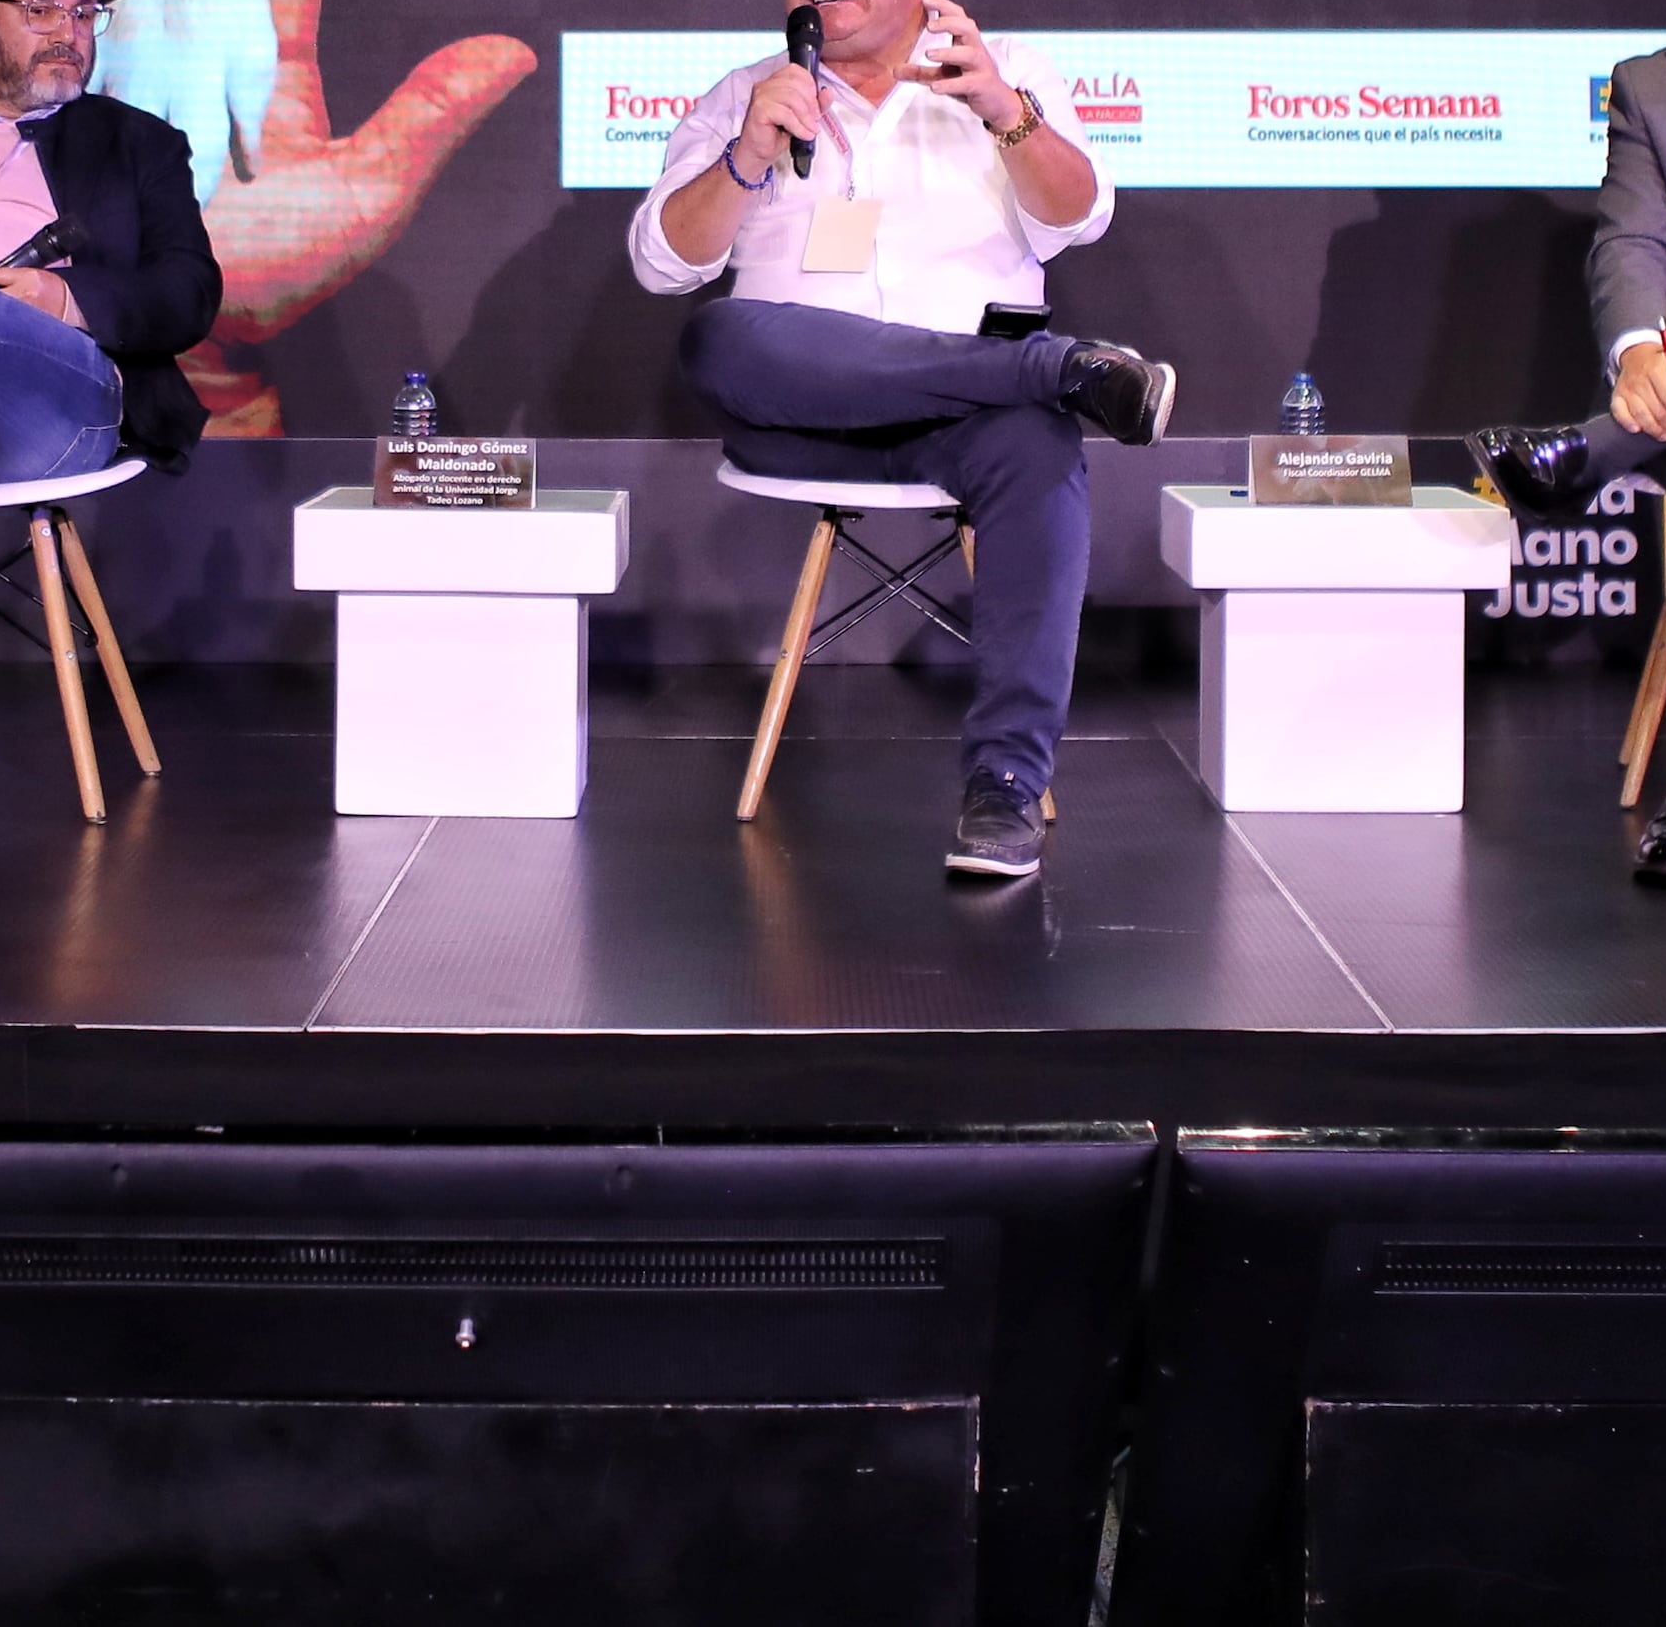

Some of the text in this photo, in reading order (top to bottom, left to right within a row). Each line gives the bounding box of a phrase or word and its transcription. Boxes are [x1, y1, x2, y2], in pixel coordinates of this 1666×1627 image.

[1064, 72, 1141, 98] ALÍA
[605, 85, 701, 120] Foro
[1247, 85, 1503, 120] Foros Semana
[1248, 126, 1503, 145] Conversaciones que el país necesita
[1589, 133, 1605, 143] En
[388, 441, 528, 456] Luis Domingo Gómez
[418, 458, 496, 471] Maldonado
[1279, 452, 1393, 467] Alejandro Gaviria
[393, 474, 521, 485] Abogado y docente en derecho
[1284, 468, 1306, 477] Fiscal
[1307, 468, 1359, 477] Coordinador
[393, 485, 518, 496] animal de la Universidad Jorge
[427, 496, 483, 505] Tadeo Lozano
